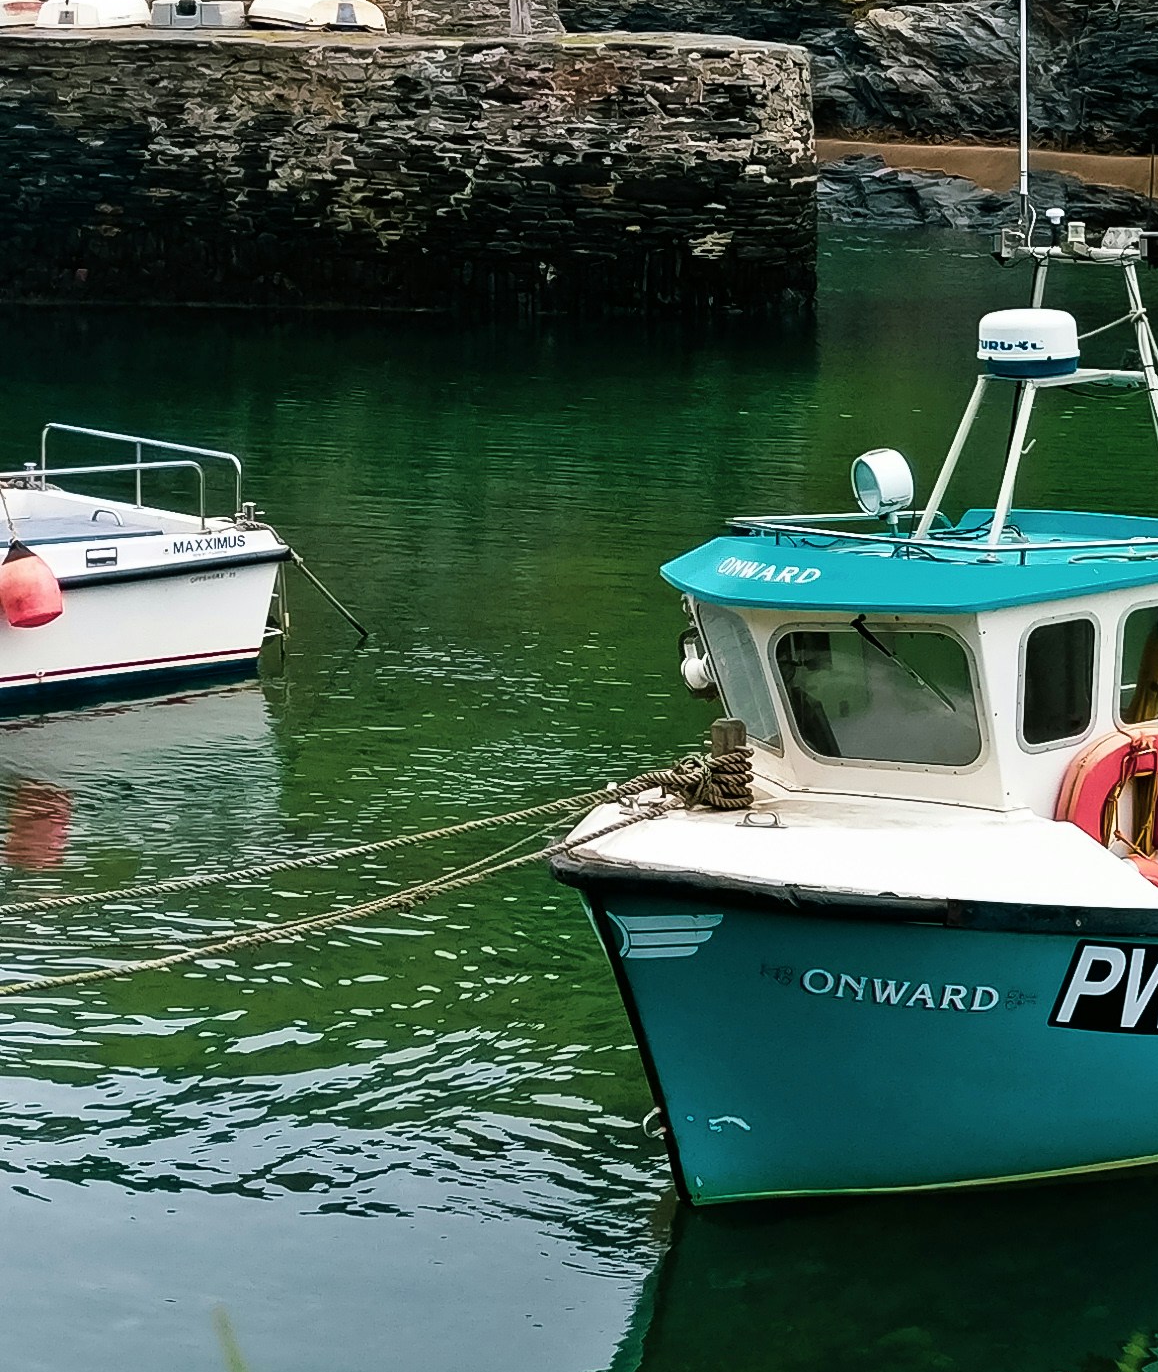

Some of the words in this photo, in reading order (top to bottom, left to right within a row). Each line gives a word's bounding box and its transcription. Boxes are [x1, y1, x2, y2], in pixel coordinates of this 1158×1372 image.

[173, 535, 246, 554] MAXXIMUS
[717, 556, 822, 583] ONWARD
[801, 968, 1000, 1013] ONWARD
